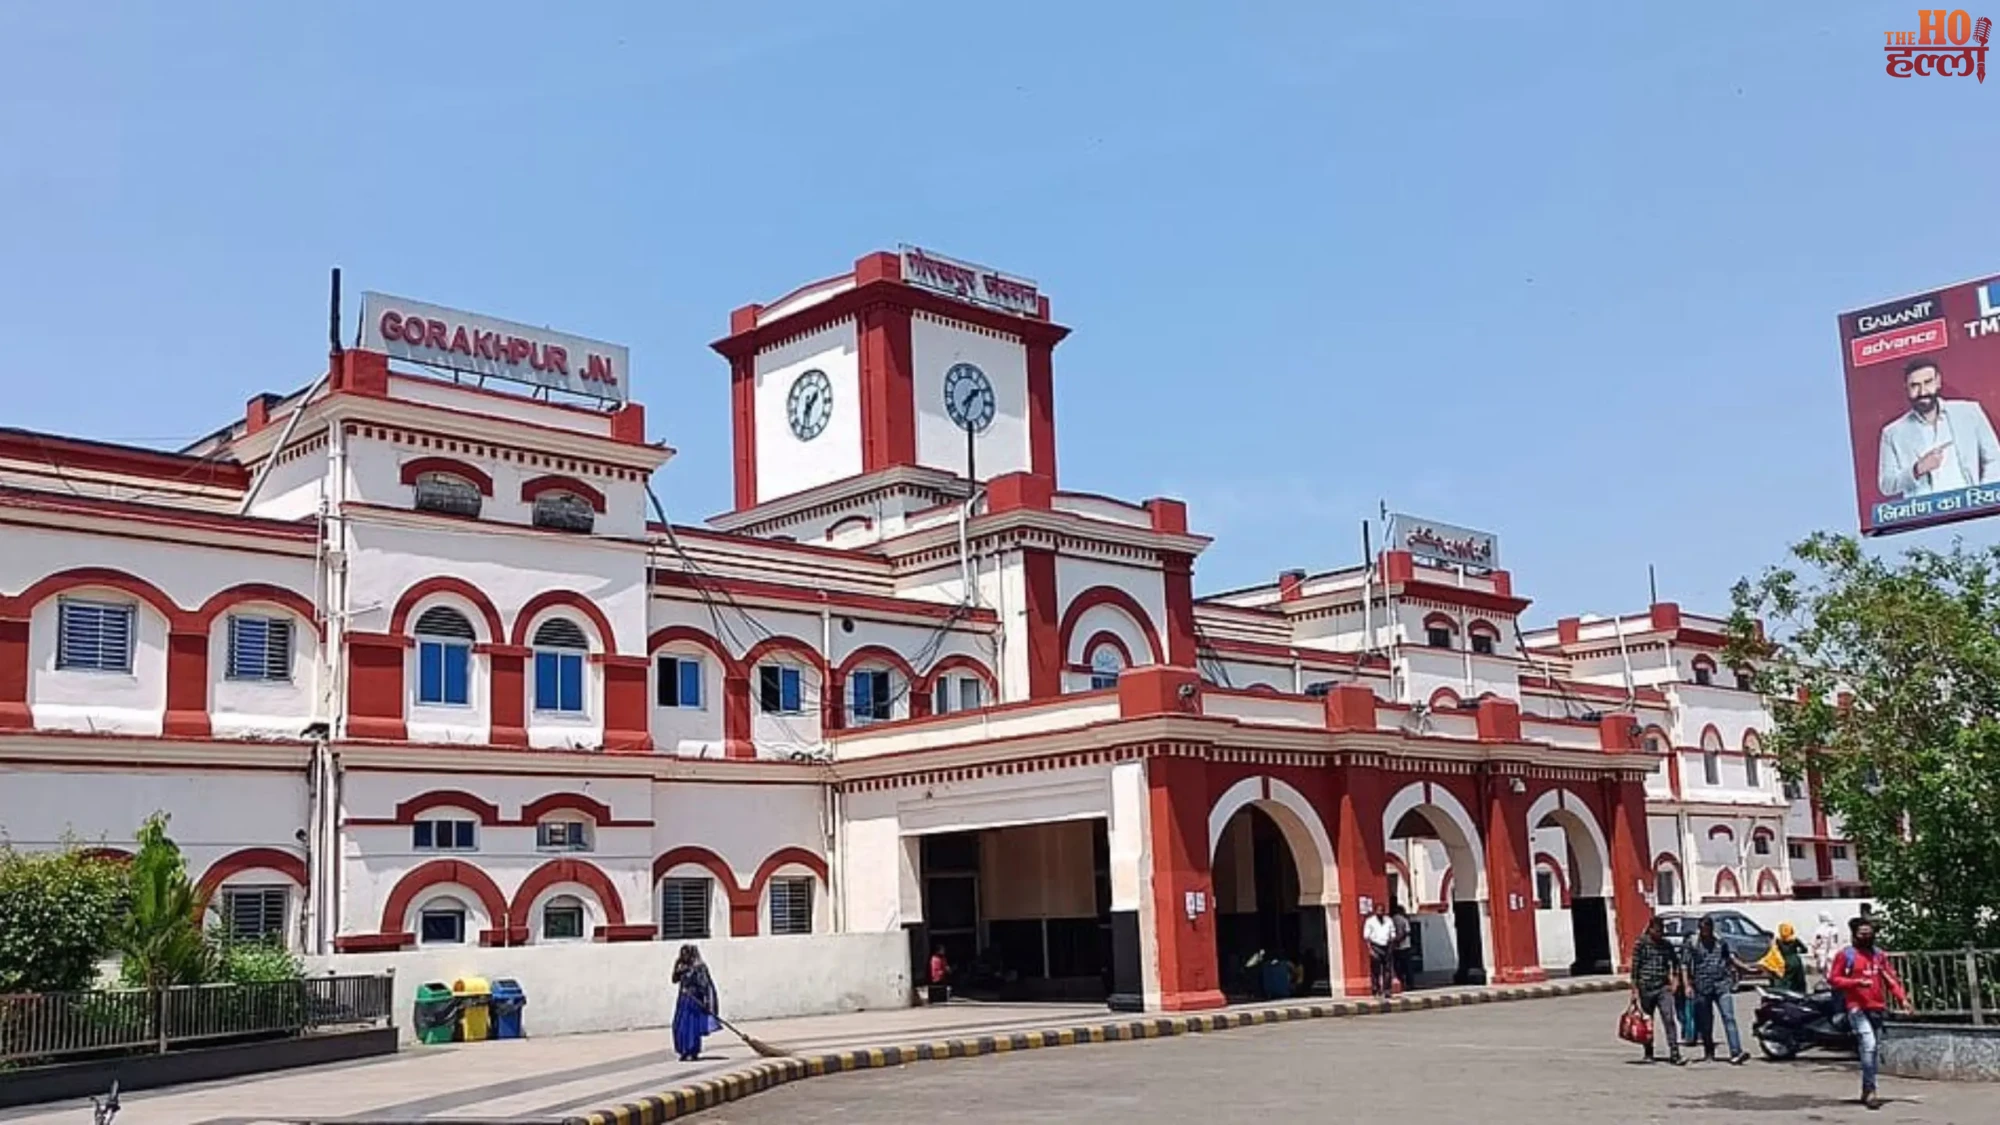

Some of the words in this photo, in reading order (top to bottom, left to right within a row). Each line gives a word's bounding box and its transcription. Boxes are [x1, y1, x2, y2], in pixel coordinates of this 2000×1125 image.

[380, 310, 568, 376] GORAKHPUR
[1862, 329, 1937, 356] advance
[1877, 499, 1932, 522] निर्माण
[1936, 496, 1961, 511] का
